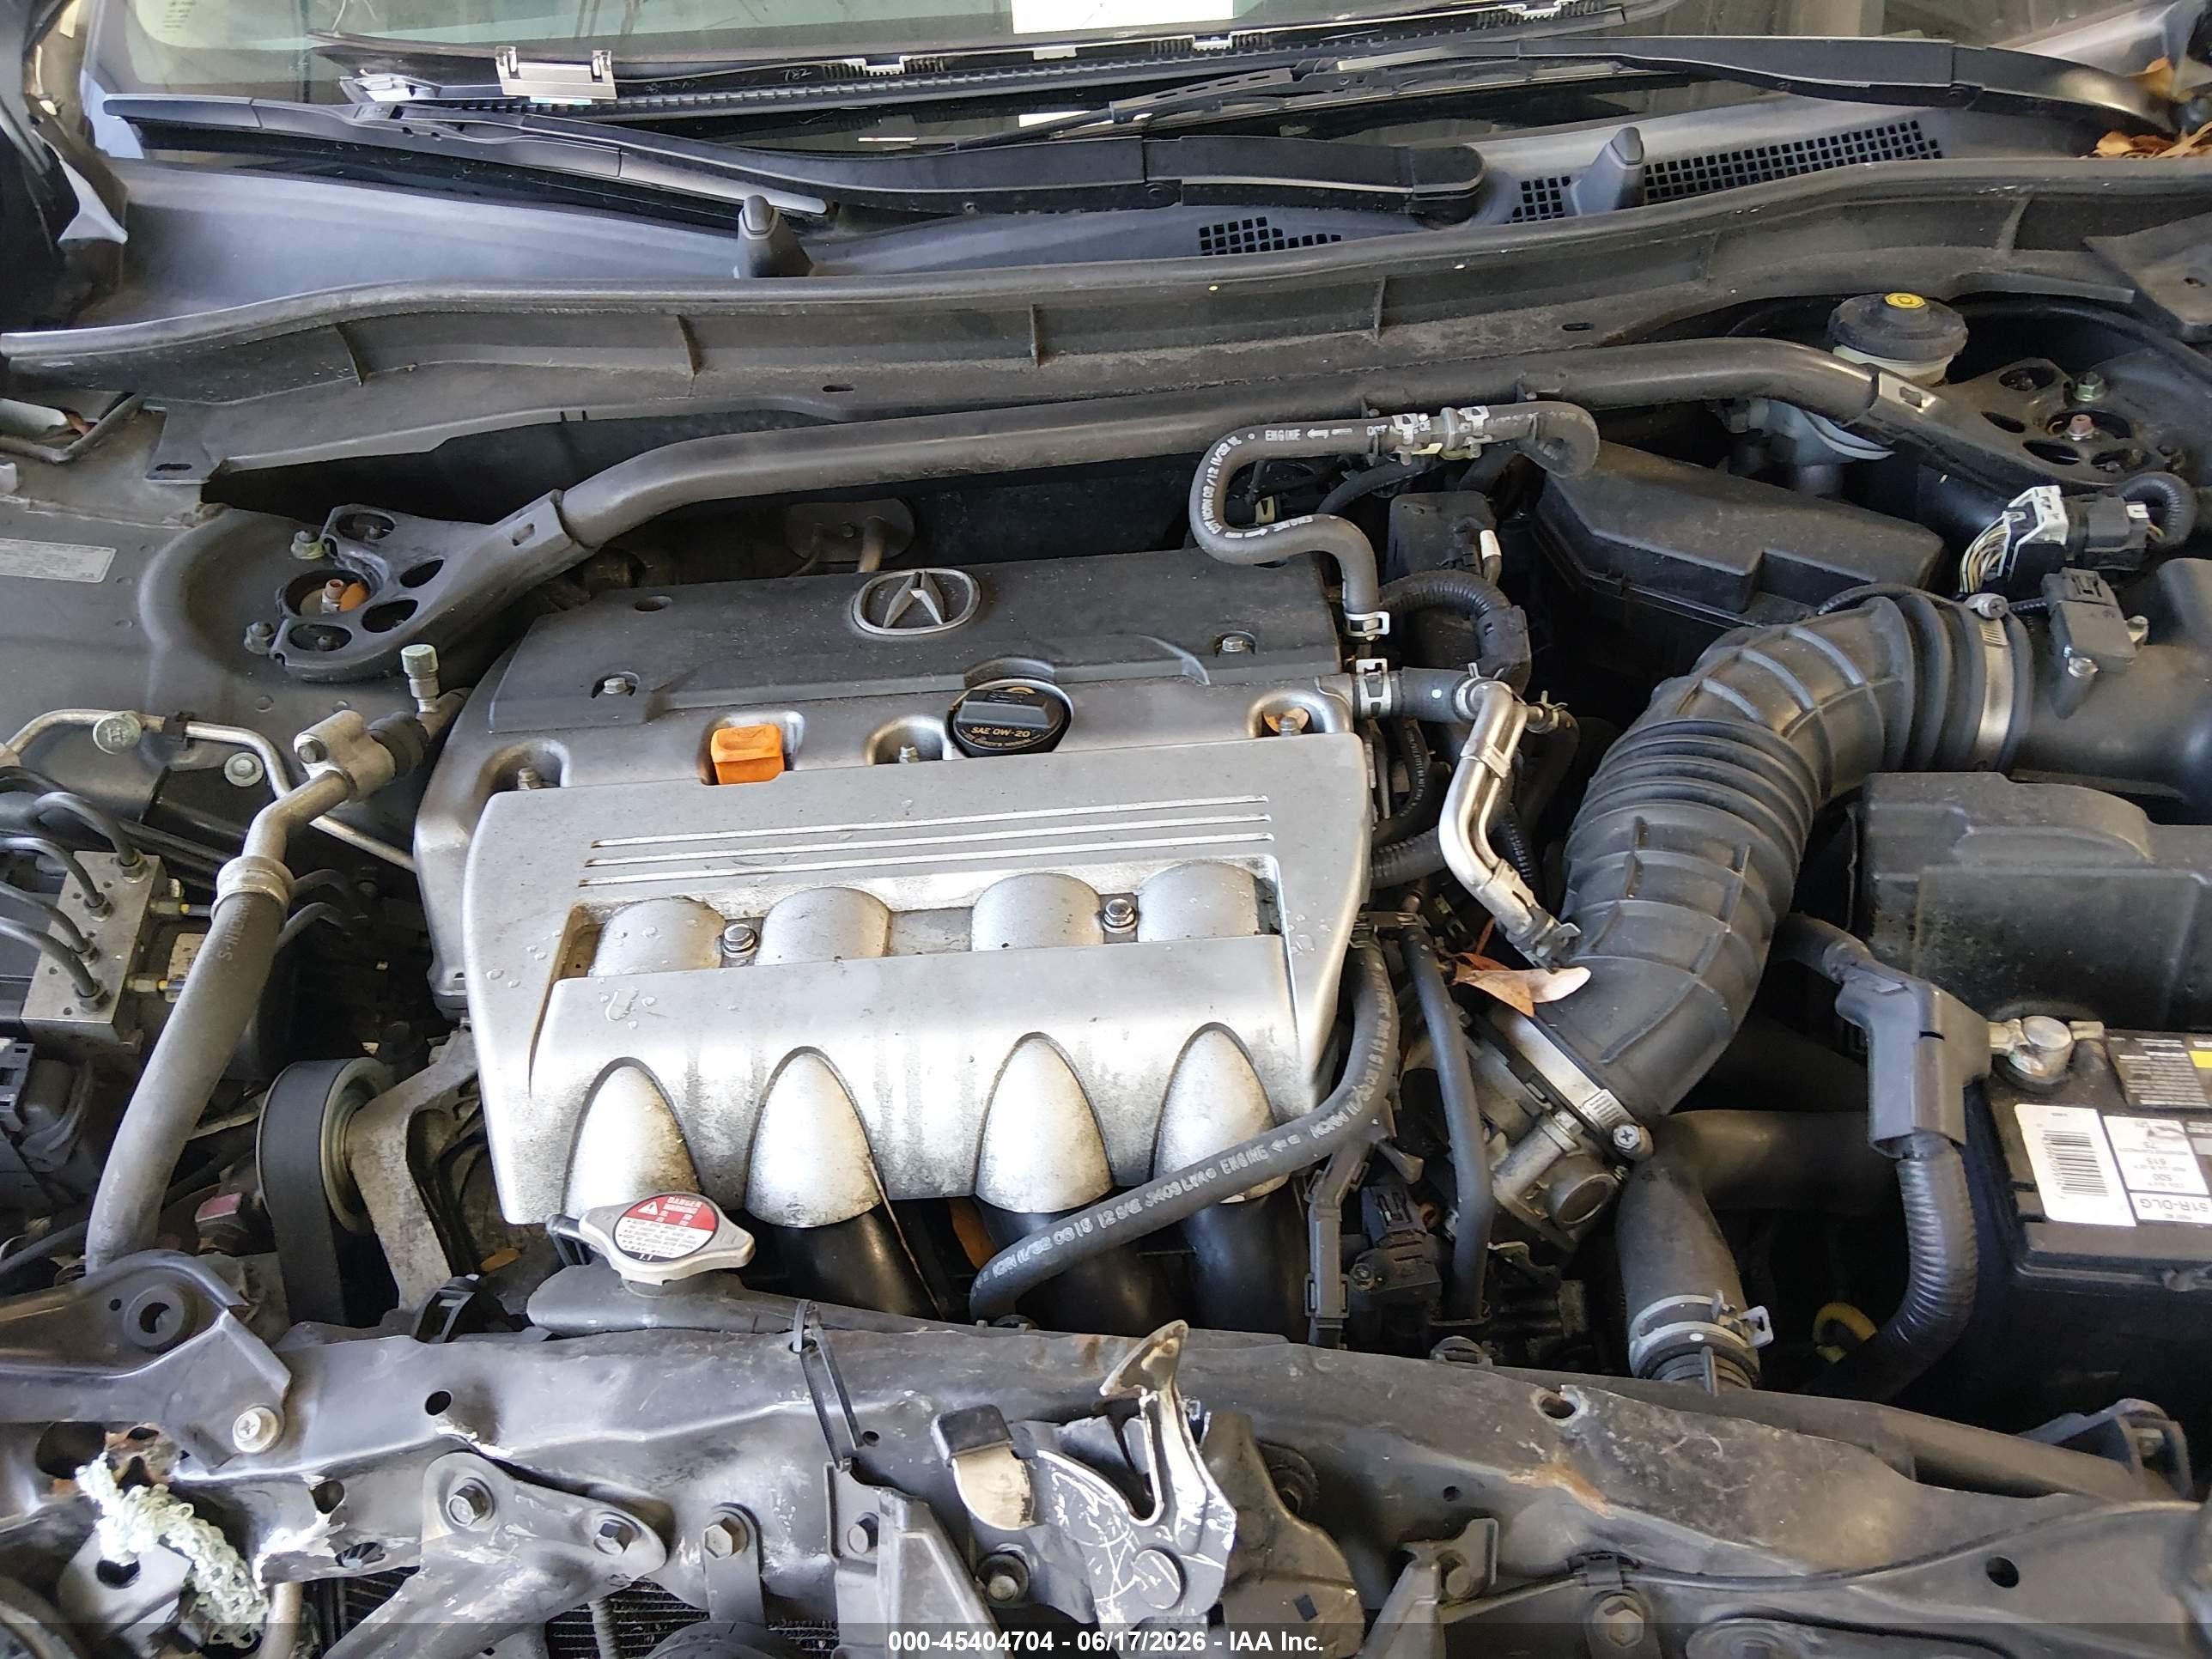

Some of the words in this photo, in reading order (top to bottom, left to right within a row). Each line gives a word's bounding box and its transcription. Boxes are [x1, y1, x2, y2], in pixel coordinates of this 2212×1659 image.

[1264, 428, 1301, 441] ENGINE
[970, 726, 992, 735] SAE
[992, 728, 1030, 738] 0W-20
[1219, 1144, 1270, 1175] ENGINE
